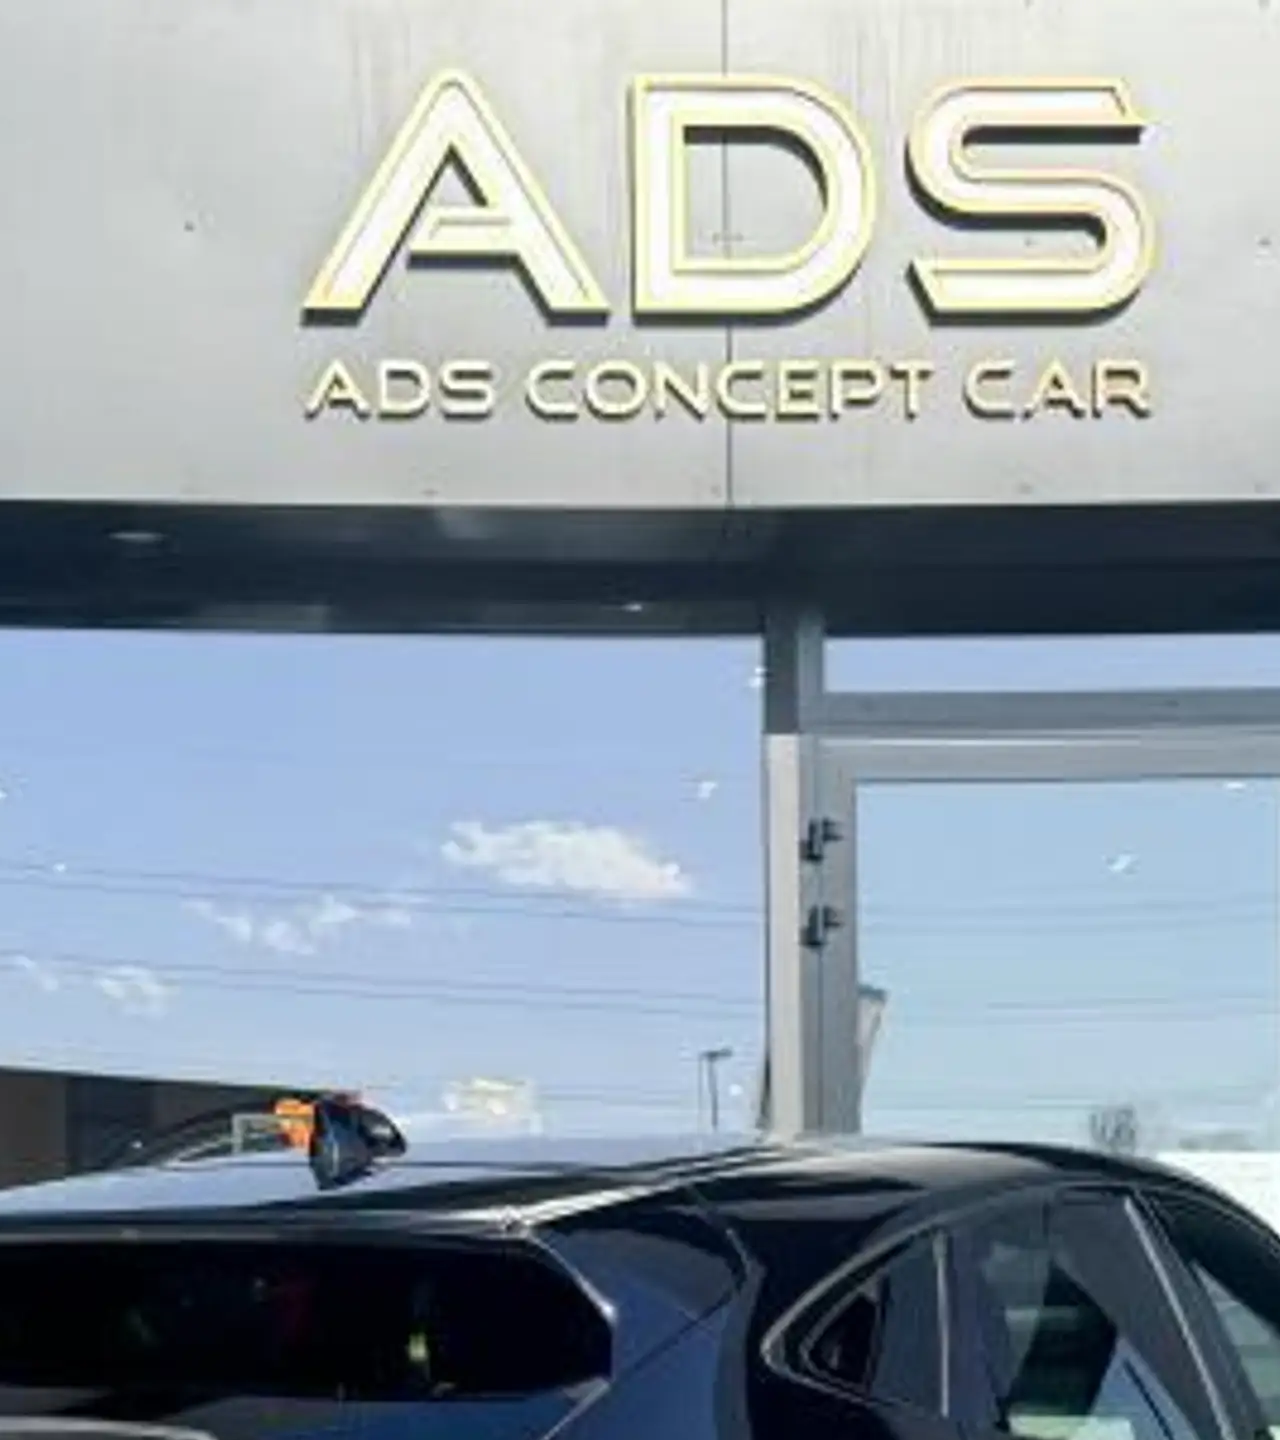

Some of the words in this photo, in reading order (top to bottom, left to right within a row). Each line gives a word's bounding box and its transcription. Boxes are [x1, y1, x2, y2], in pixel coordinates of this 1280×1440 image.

[303, 69, 1155, 326] ADS
[306, 360, 499, 421] ADS
[525, 360, 932, 421] CONCEPT
[963, 360, 1154, 421] CAR
